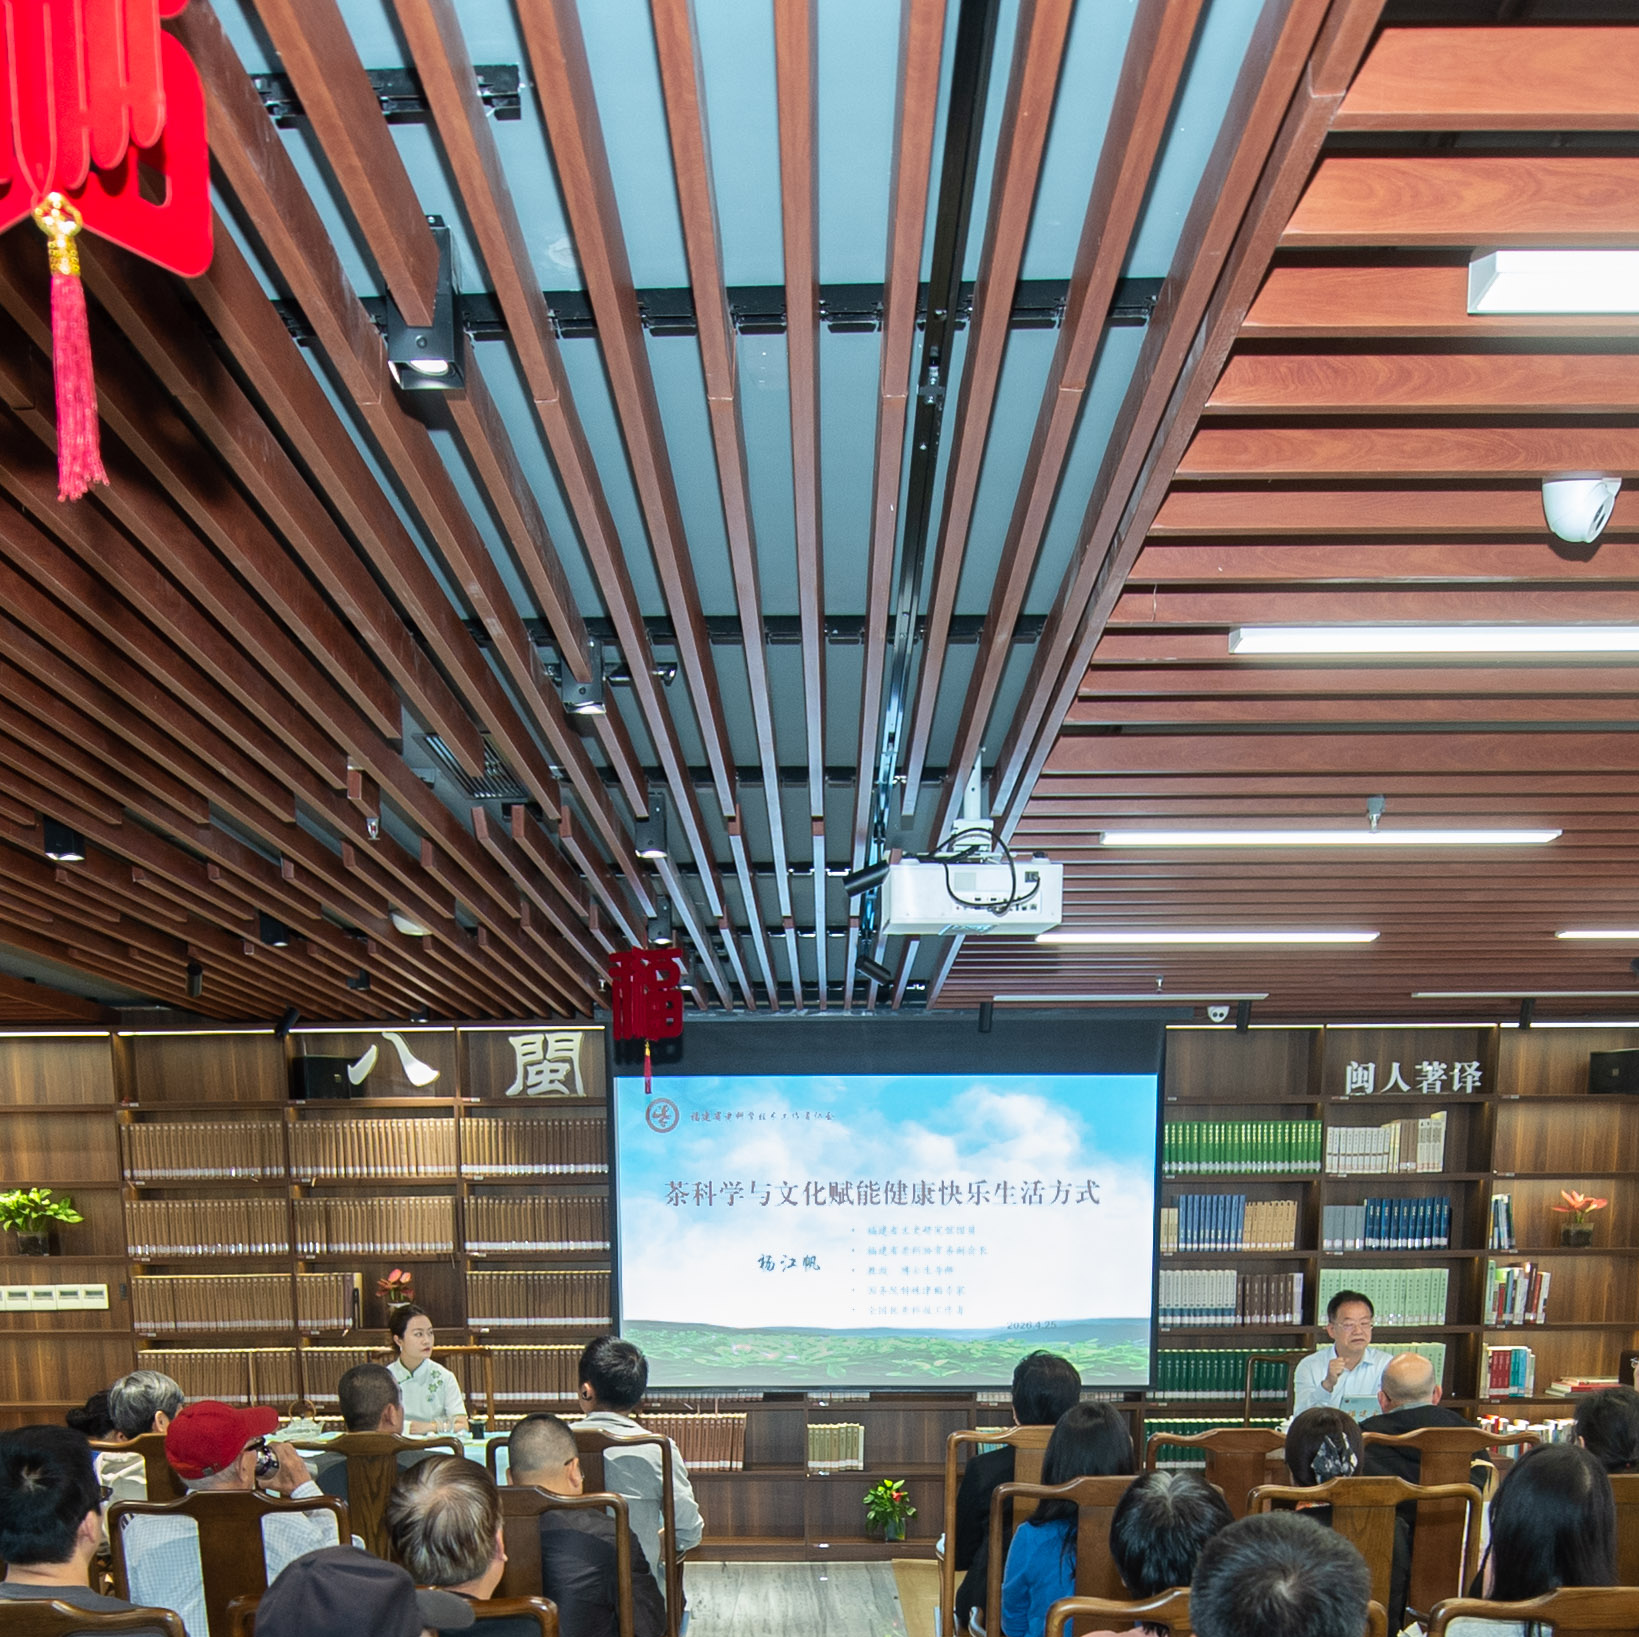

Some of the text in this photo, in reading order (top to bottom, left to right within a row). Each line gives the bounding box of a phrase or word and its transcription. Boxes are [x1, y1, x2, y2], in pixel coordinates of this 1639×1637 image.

[1345, 1060, 1482, 1094] 闽人著译
[664, 1179, 1101, 1207] 茶科学与文化赋能健康快乐生活方式
